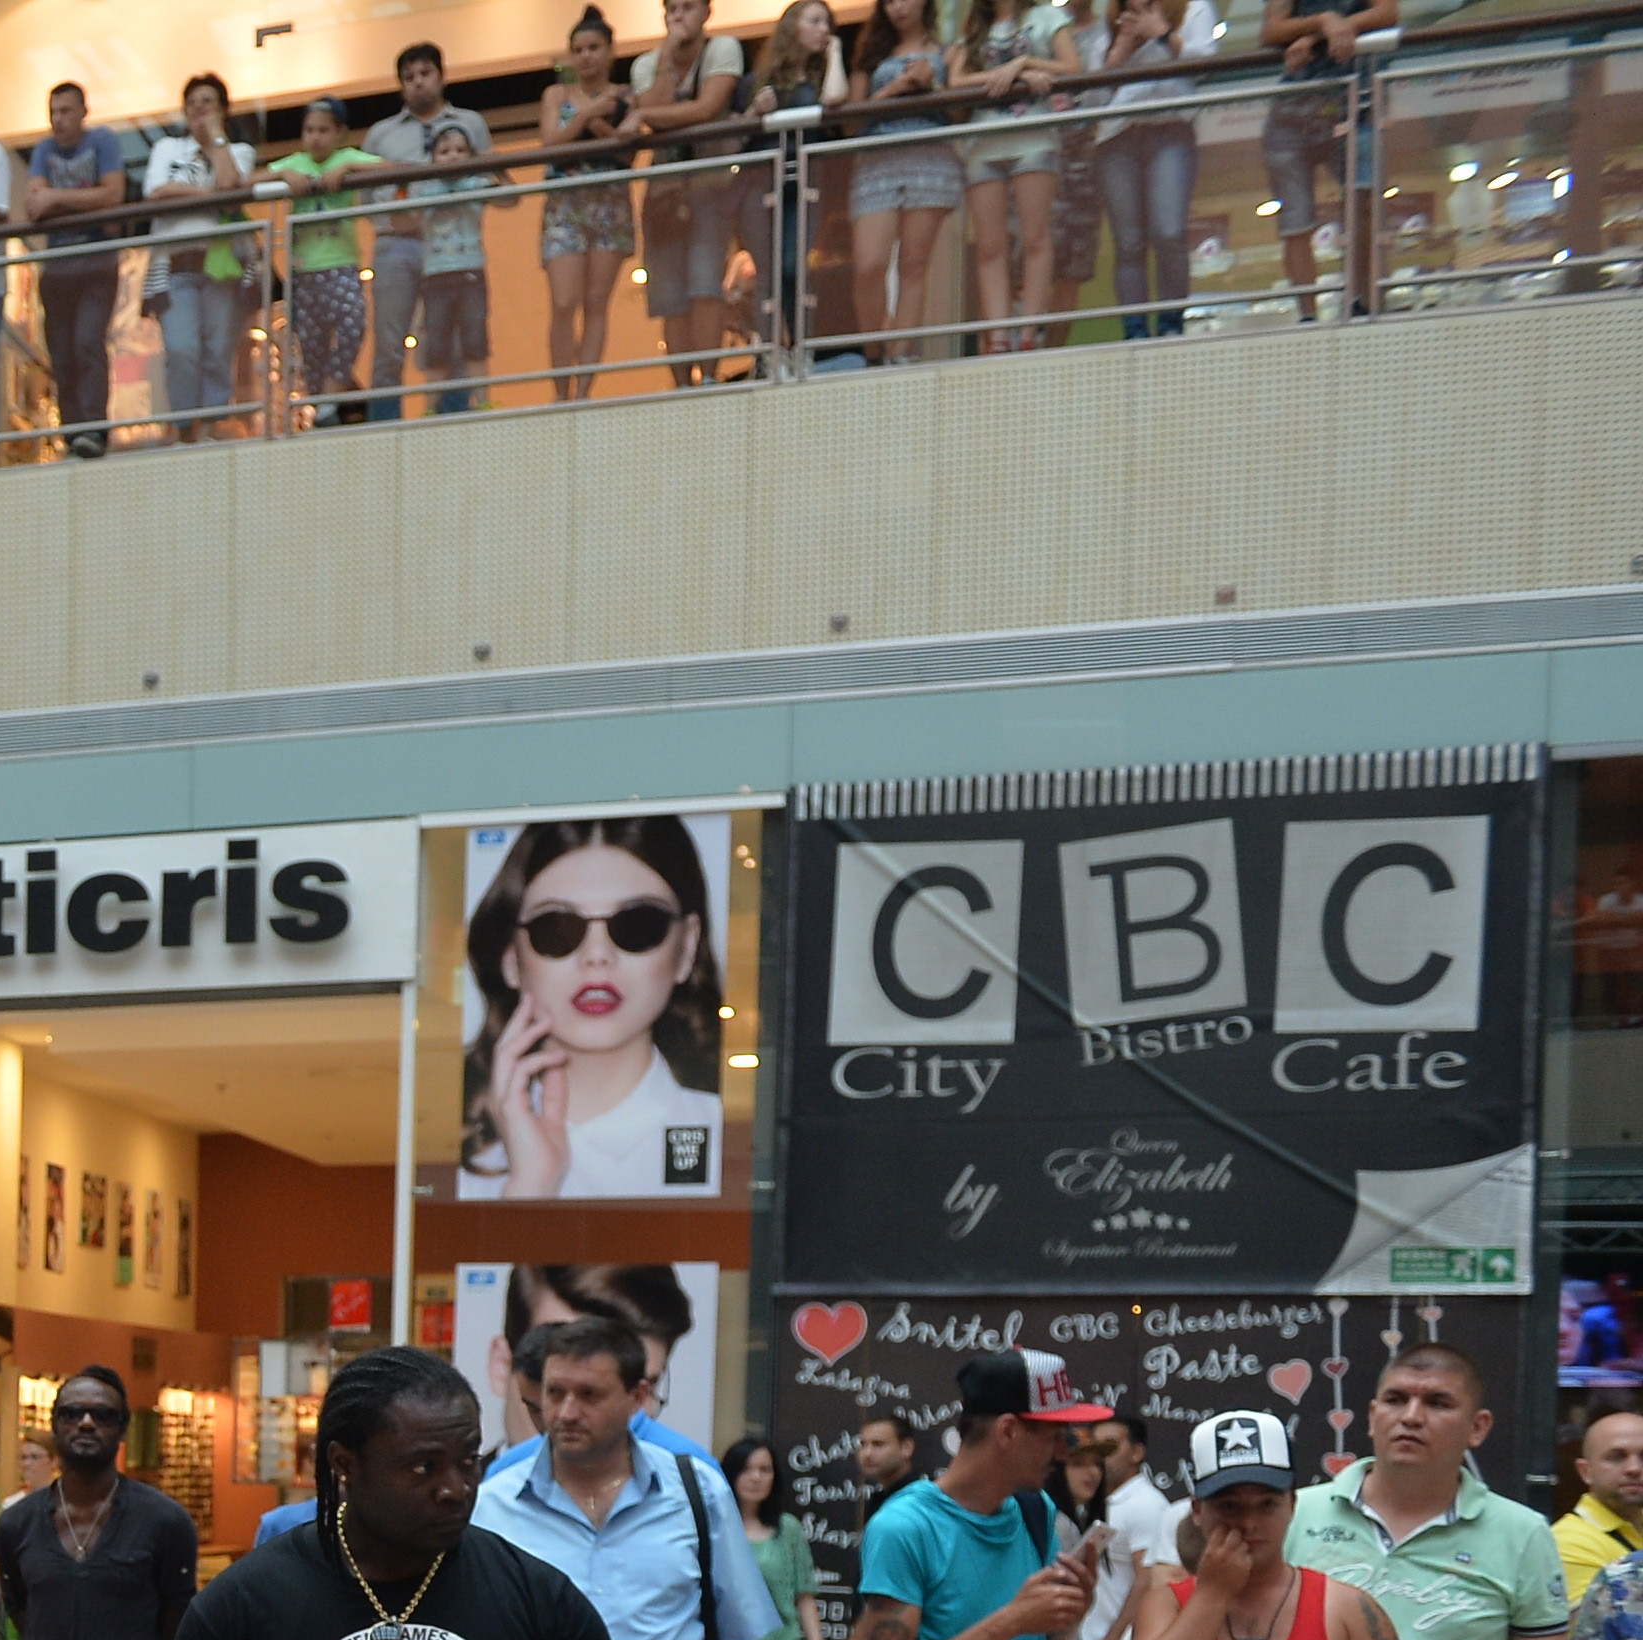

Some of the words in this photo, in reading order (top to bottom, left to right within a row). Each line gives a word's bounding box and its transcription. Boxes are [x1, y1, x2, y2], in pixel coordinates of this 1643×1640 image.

[829, 1044, 1007, 1114] City
[1078, 1013, 1254, 1068] Bistro
[1270, 1030, 1470, 1094] Cafe
[942, 1163, 999, 1240] by
[1043, 1149, 1234, 1211] Elizabeth
[875, 1301, 1025, 1354] Snitel
[1143, 1299, 1327, 1340] Cheeseburger
[1142, 1343, 1264, 1390] Paste
